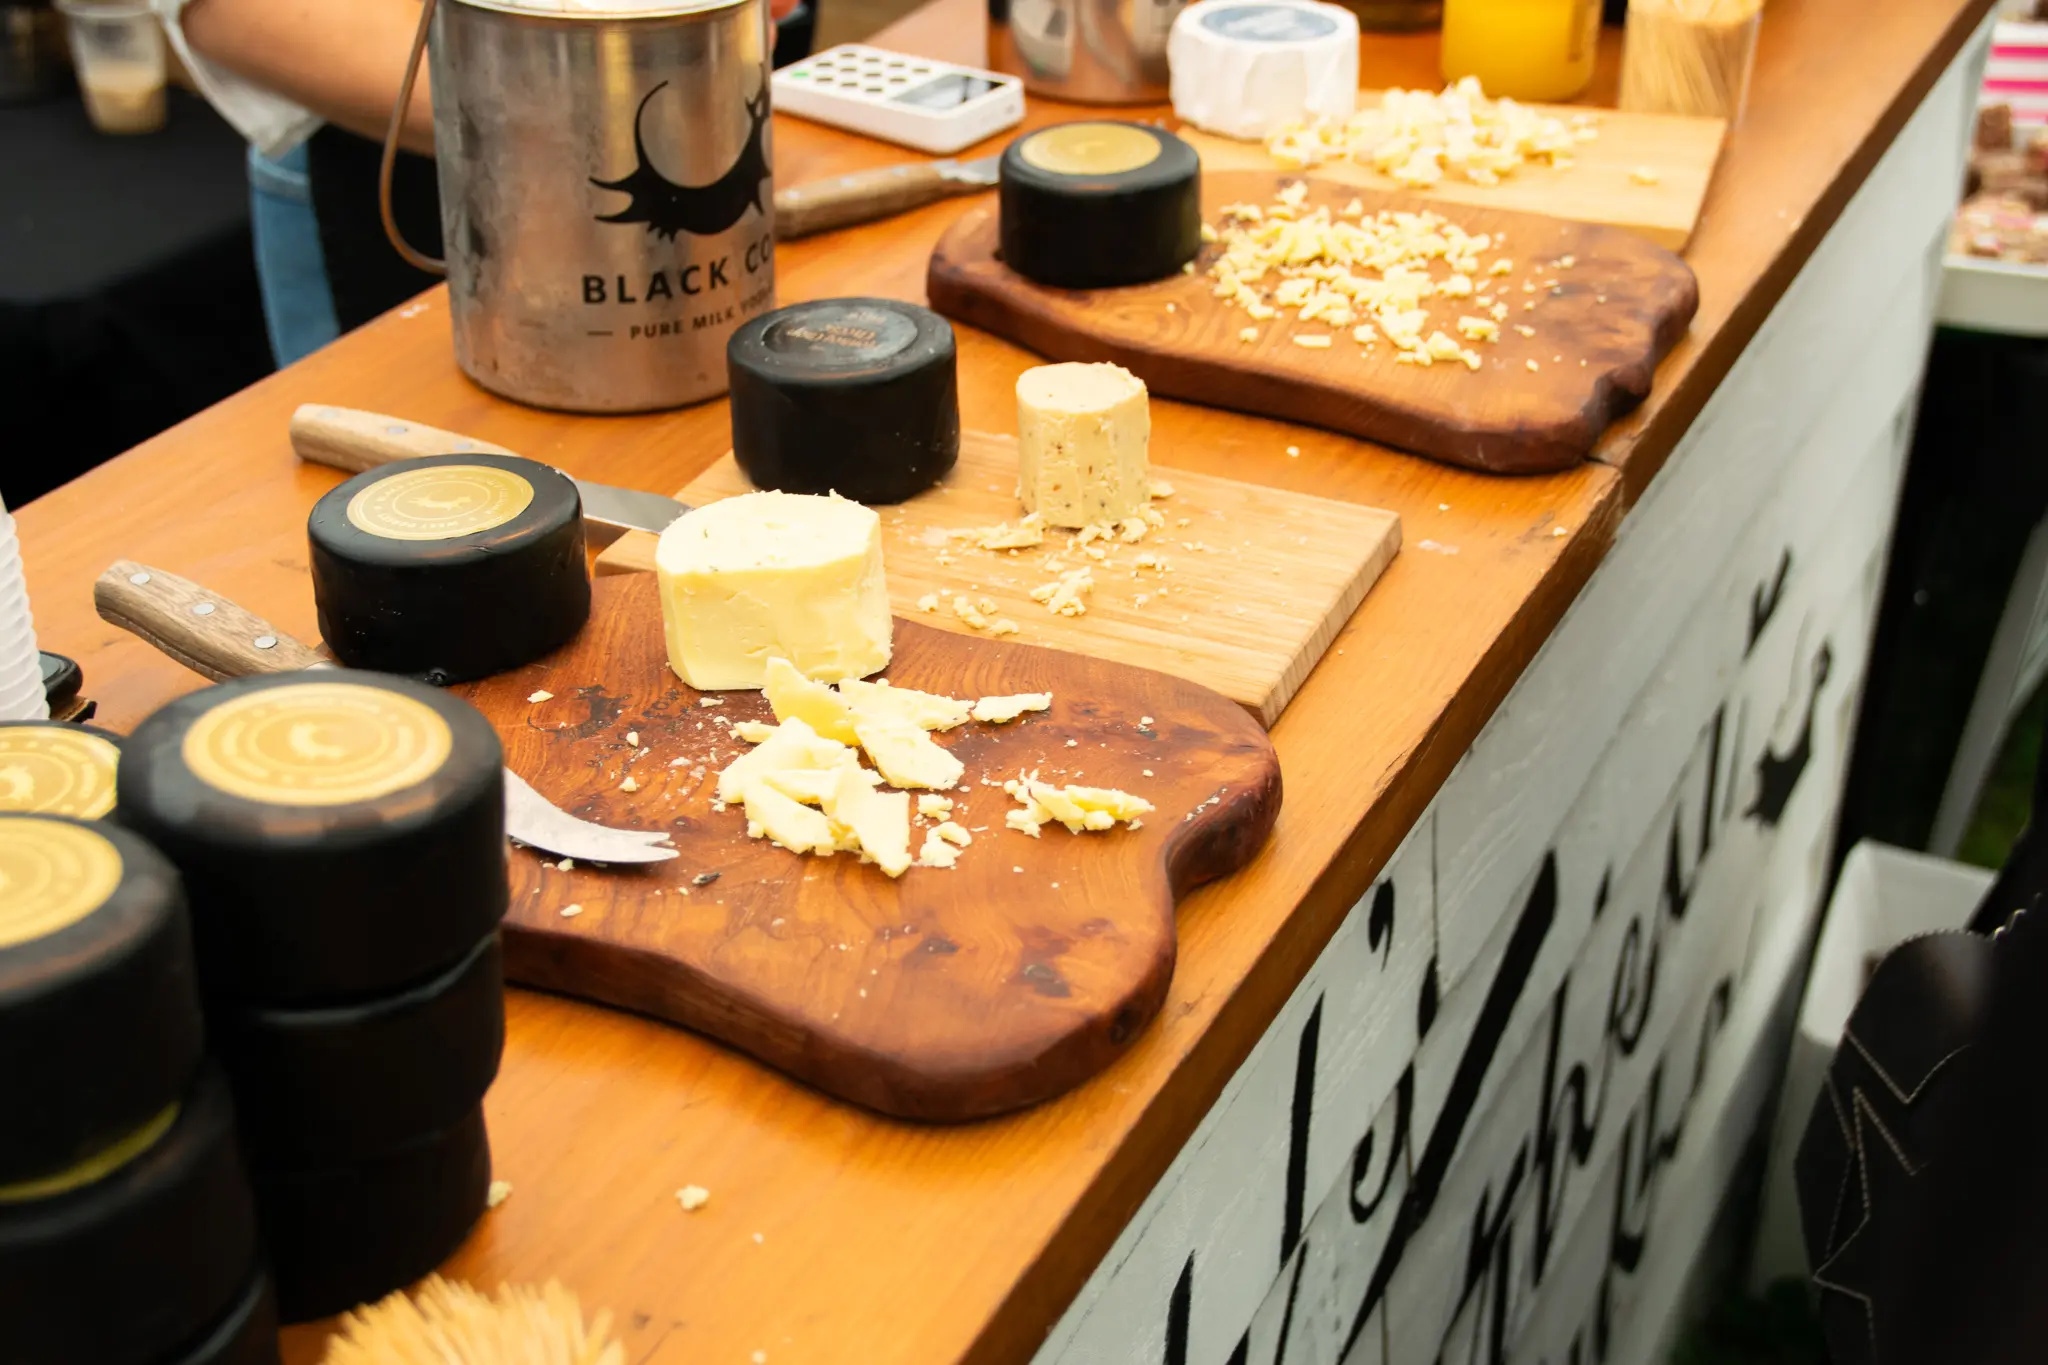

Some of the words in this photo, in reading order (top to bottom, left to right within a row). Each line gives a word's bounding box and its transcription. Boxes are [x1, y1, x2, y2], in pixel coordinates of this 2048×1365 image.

[582, 257, 728, 305] BLACK
[629, 320, 683, 339] PURE
[692, 305, 735, 330] MILK
